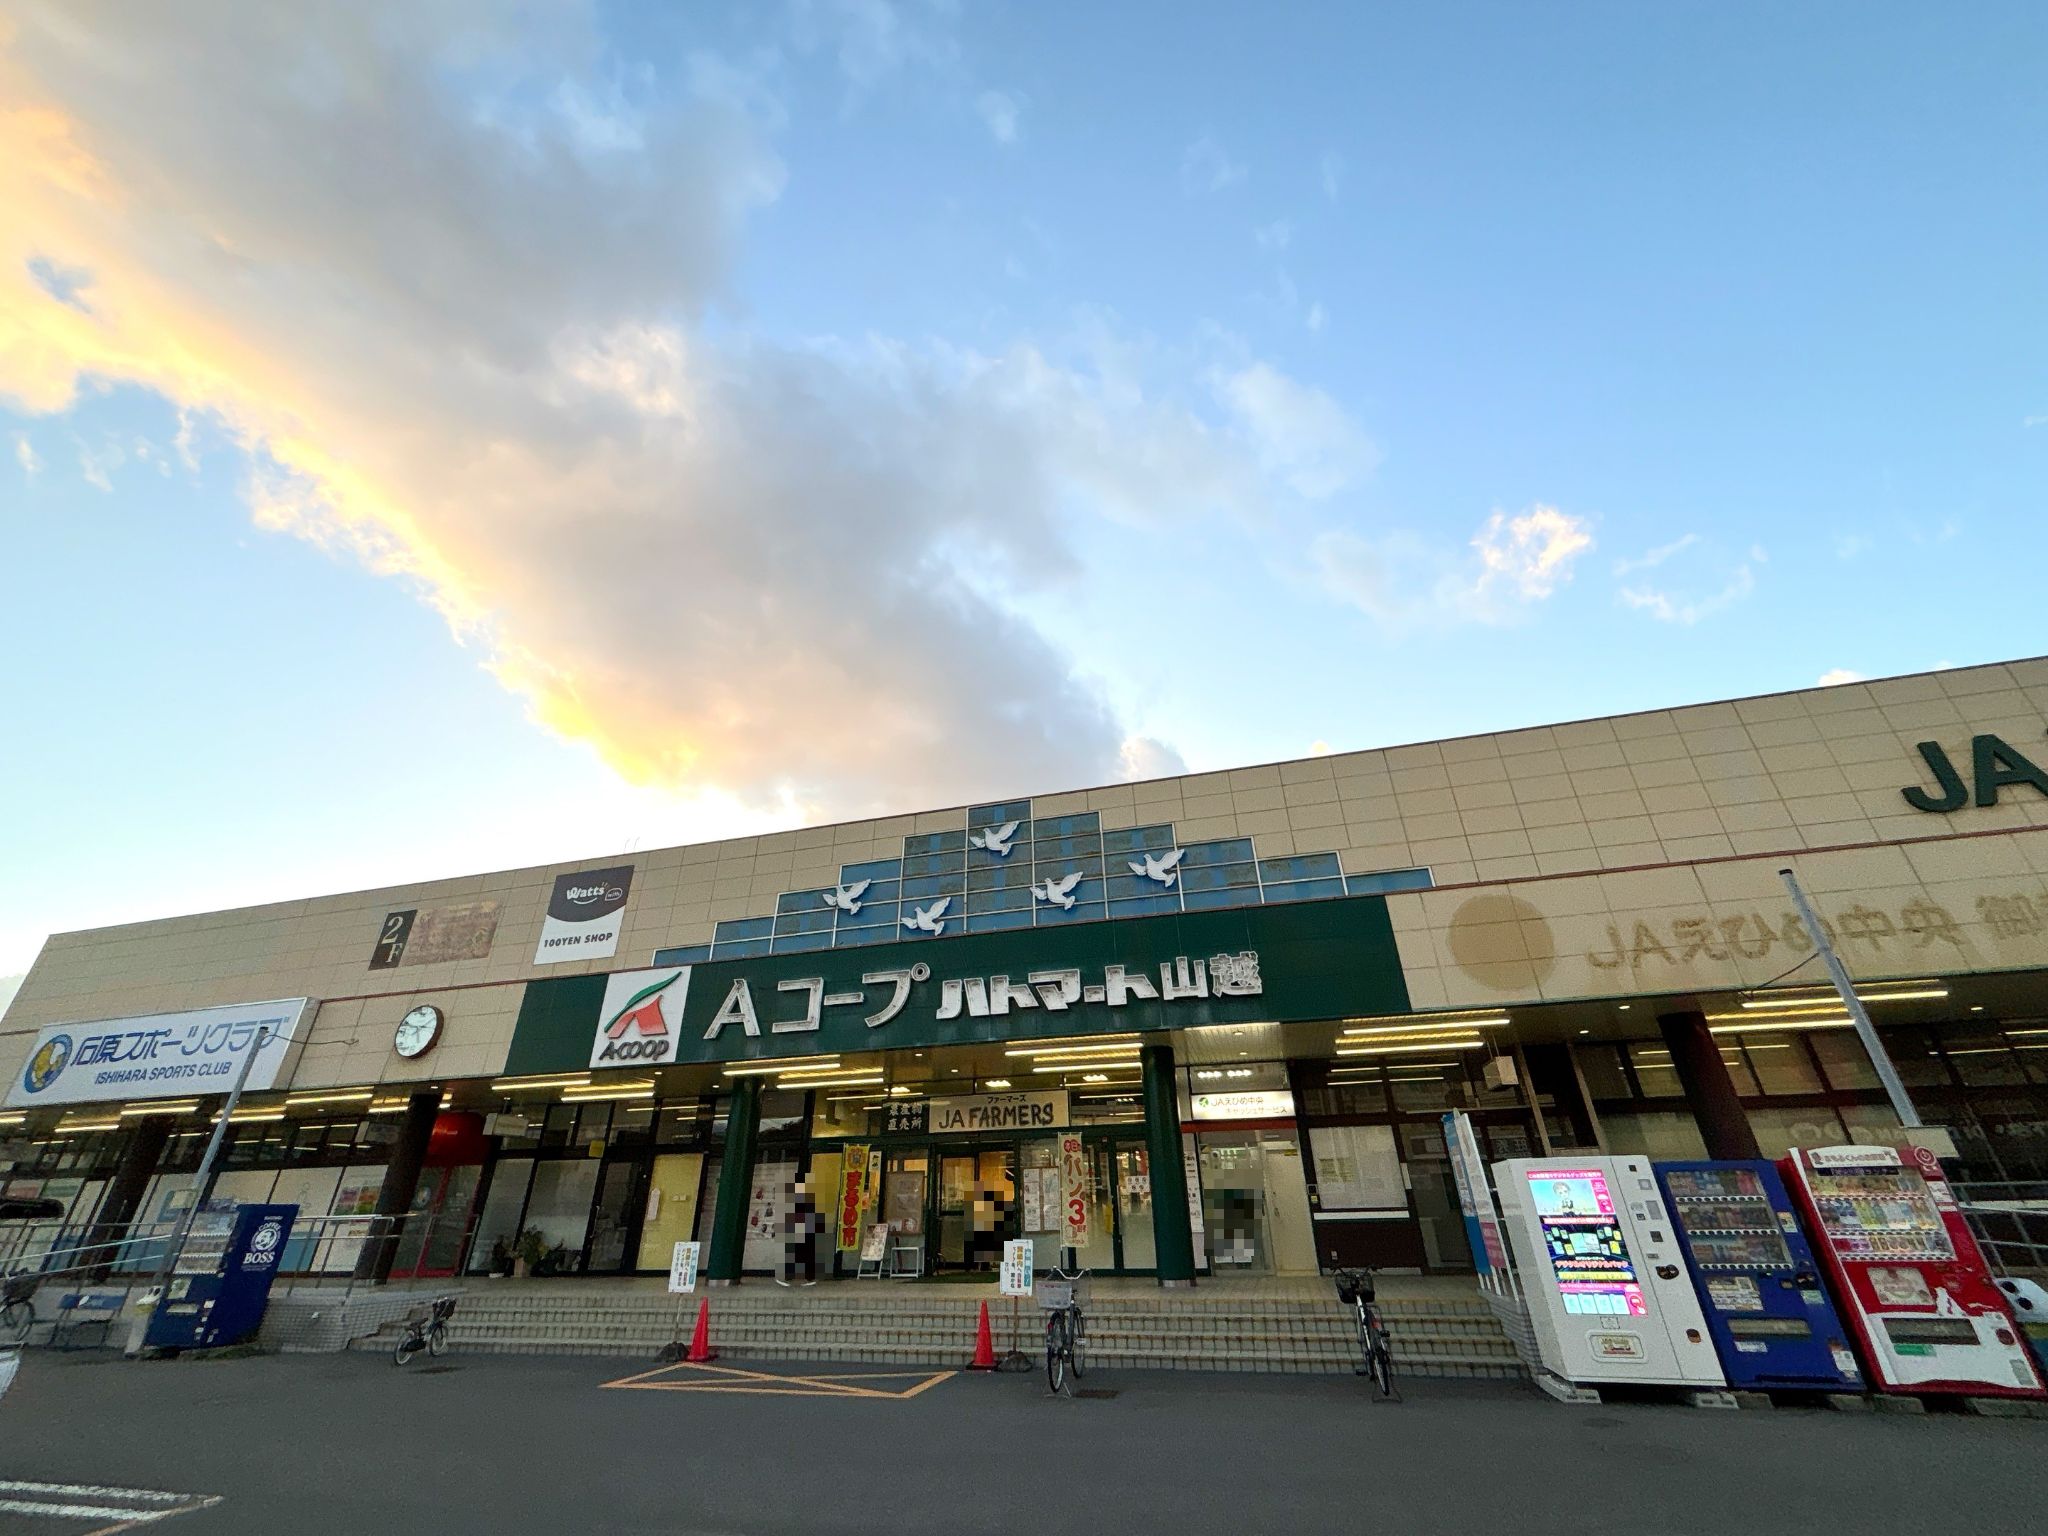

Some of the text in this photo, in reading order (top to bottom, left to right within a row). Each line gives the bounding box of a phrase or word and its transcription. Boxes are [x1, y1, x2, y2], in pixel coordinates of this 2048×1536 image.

[566, 884, 605, 900] Watts
[543, 932, 613, 948] 100YEN SHOP
[70, 1016, 290, 1067] 石原スポーツクラブ
[94, 1061, 233, 1085] ISHIHARA SPORTS CLUB
[939, 1101, 1054, 1129] JA FARMERS
[887, 1117, 923, 1131] 直売所
[243, 1252, 275, 1264] BOSS
